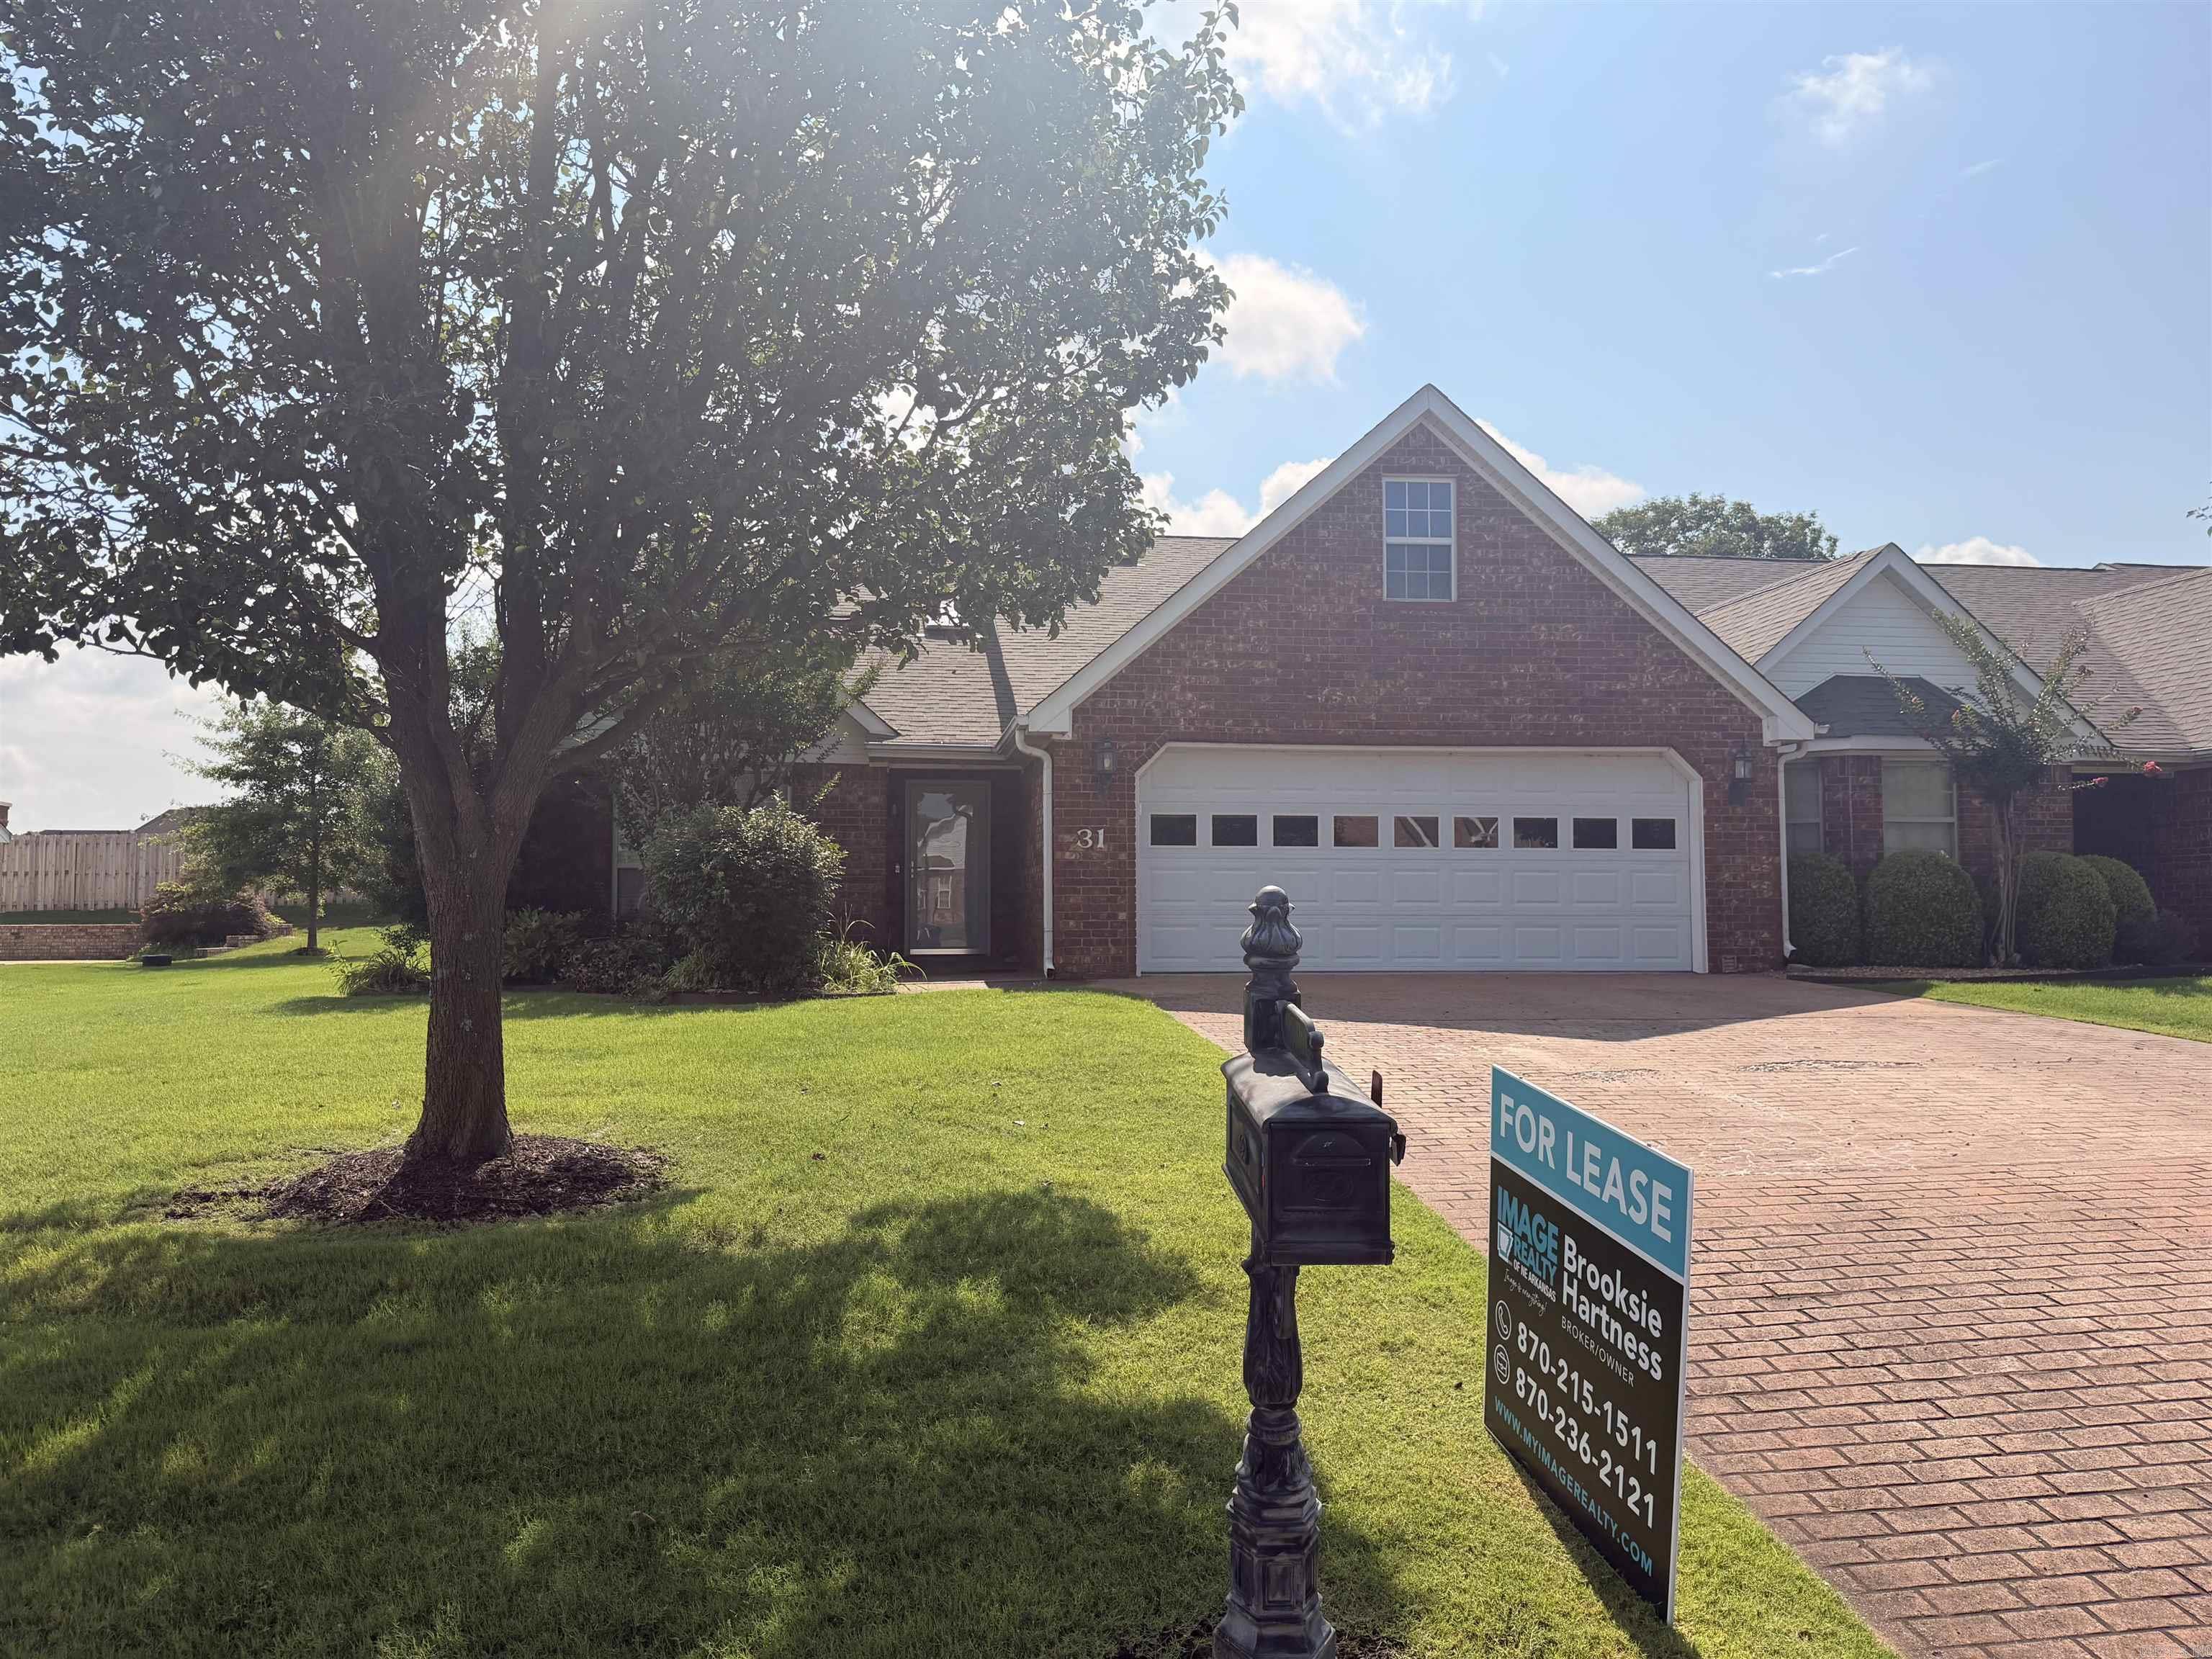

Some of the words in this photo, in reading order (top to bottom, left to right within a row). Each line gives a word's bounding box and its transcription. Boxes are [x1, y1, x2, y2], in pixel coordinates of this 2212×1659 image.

[1076, 828, 1105, 849] 31
[1500, 1093, 1555, 1169] FOR
[1566, 1130, 1673, 1244] LEASE
[1498, 1186, 1559, 1262] IMAGE
[1514, 1233, 1557, 1286] REALTY
[1513, 1259, 1520, 1272] OF
[1520, 1264, 1529, 1280] NE
[1528, 1272, 1556, 1302] ARKANSAS
[1563, 1234, 1663, 1339] Brooksie
[1563, 1270, 1663, 1381] Hartness
[1517, 1321, 1656, 1475] 870-215-1511
[1561, 1316, 1635, 1388] BROKER/OWNER
[1494, 1396, 1653, 1577] WWW.MYIMAGEREALTY.COM
[1516, 1367, 1653, 1529] 870-236-2121
